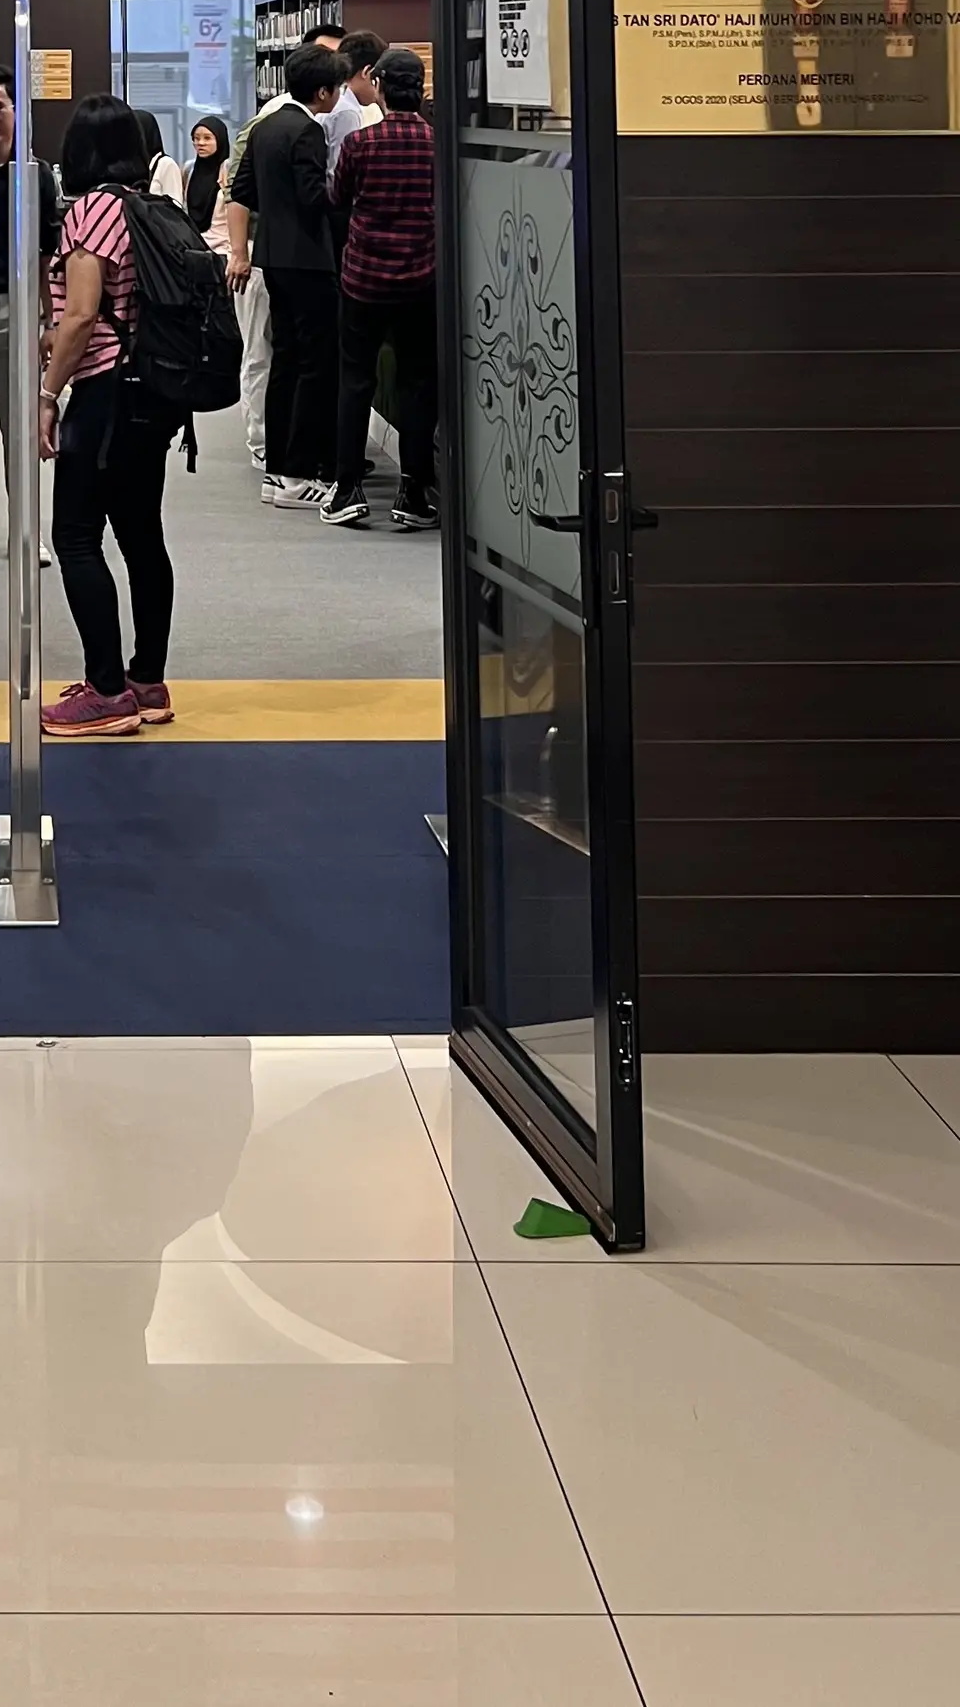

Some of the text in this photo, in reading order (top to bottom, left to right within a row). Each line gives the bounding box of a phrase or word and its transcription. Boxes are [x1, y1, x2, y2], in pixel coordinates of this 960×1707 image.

[623, 14, 650, 27] TAN
[653, 14, 677, 27] SRI
[724, 13, 756, 27] HAJI
[759, 13, 836, 26] MUHYIDDIN
[840, 13, 863, 25] BIN
[867, 12, 899, 25] HAJI
[738, 73, 855, 87] PERDANA MENTERI
[661, 95, 673, 105] 25
[674, 95, 703, 106] OGOS
[705, 95, 727, 105] 2020
